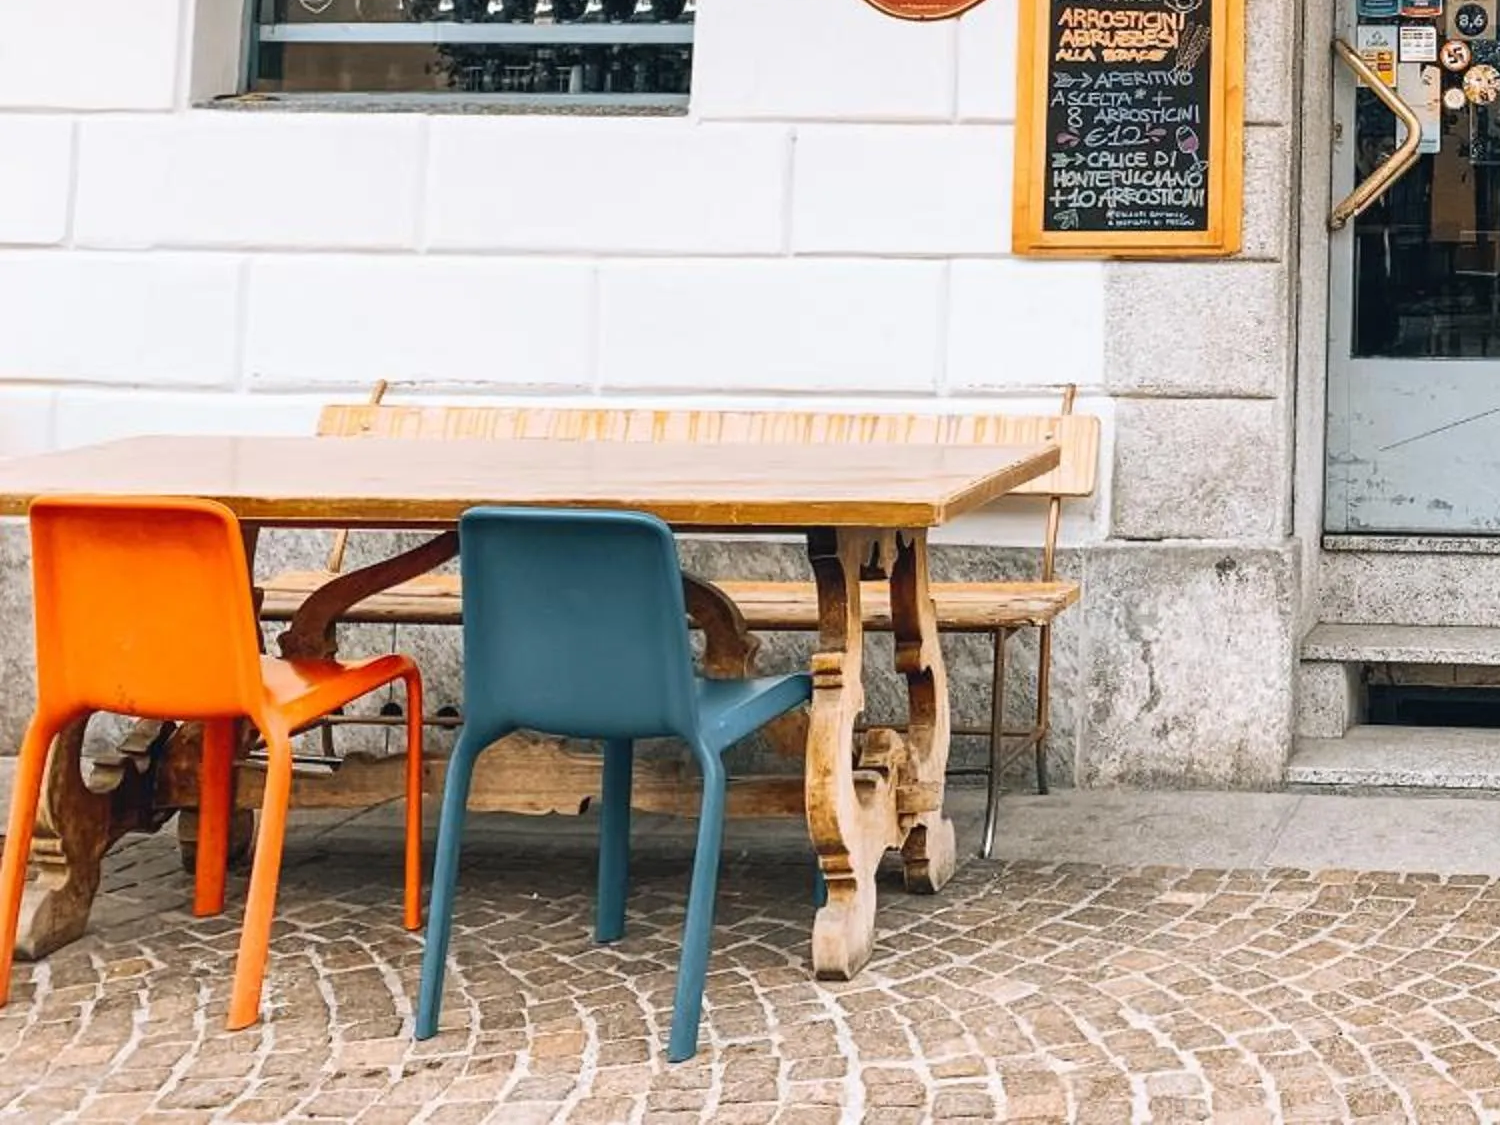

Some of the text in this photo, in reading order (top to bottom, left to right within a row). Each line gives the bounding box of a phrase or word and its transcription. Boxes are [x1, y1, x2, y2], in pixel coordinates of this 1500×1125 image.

[1057, 7, 1186, 31] ARROSTICINI
[1458, 13, 1486, 28] 8,6
[1055, 48, 1097, 62] ALLA
[1093, 70, 1193, 89] APERITIVO
[1050, 90, 1066, 108] A
[1066, 104, 1201, 128] 8 ARROSTICINI
[1086, 150, 1178, 168] CALICE DI
[1097, 187, 1205, 209] ARROSTICINI
